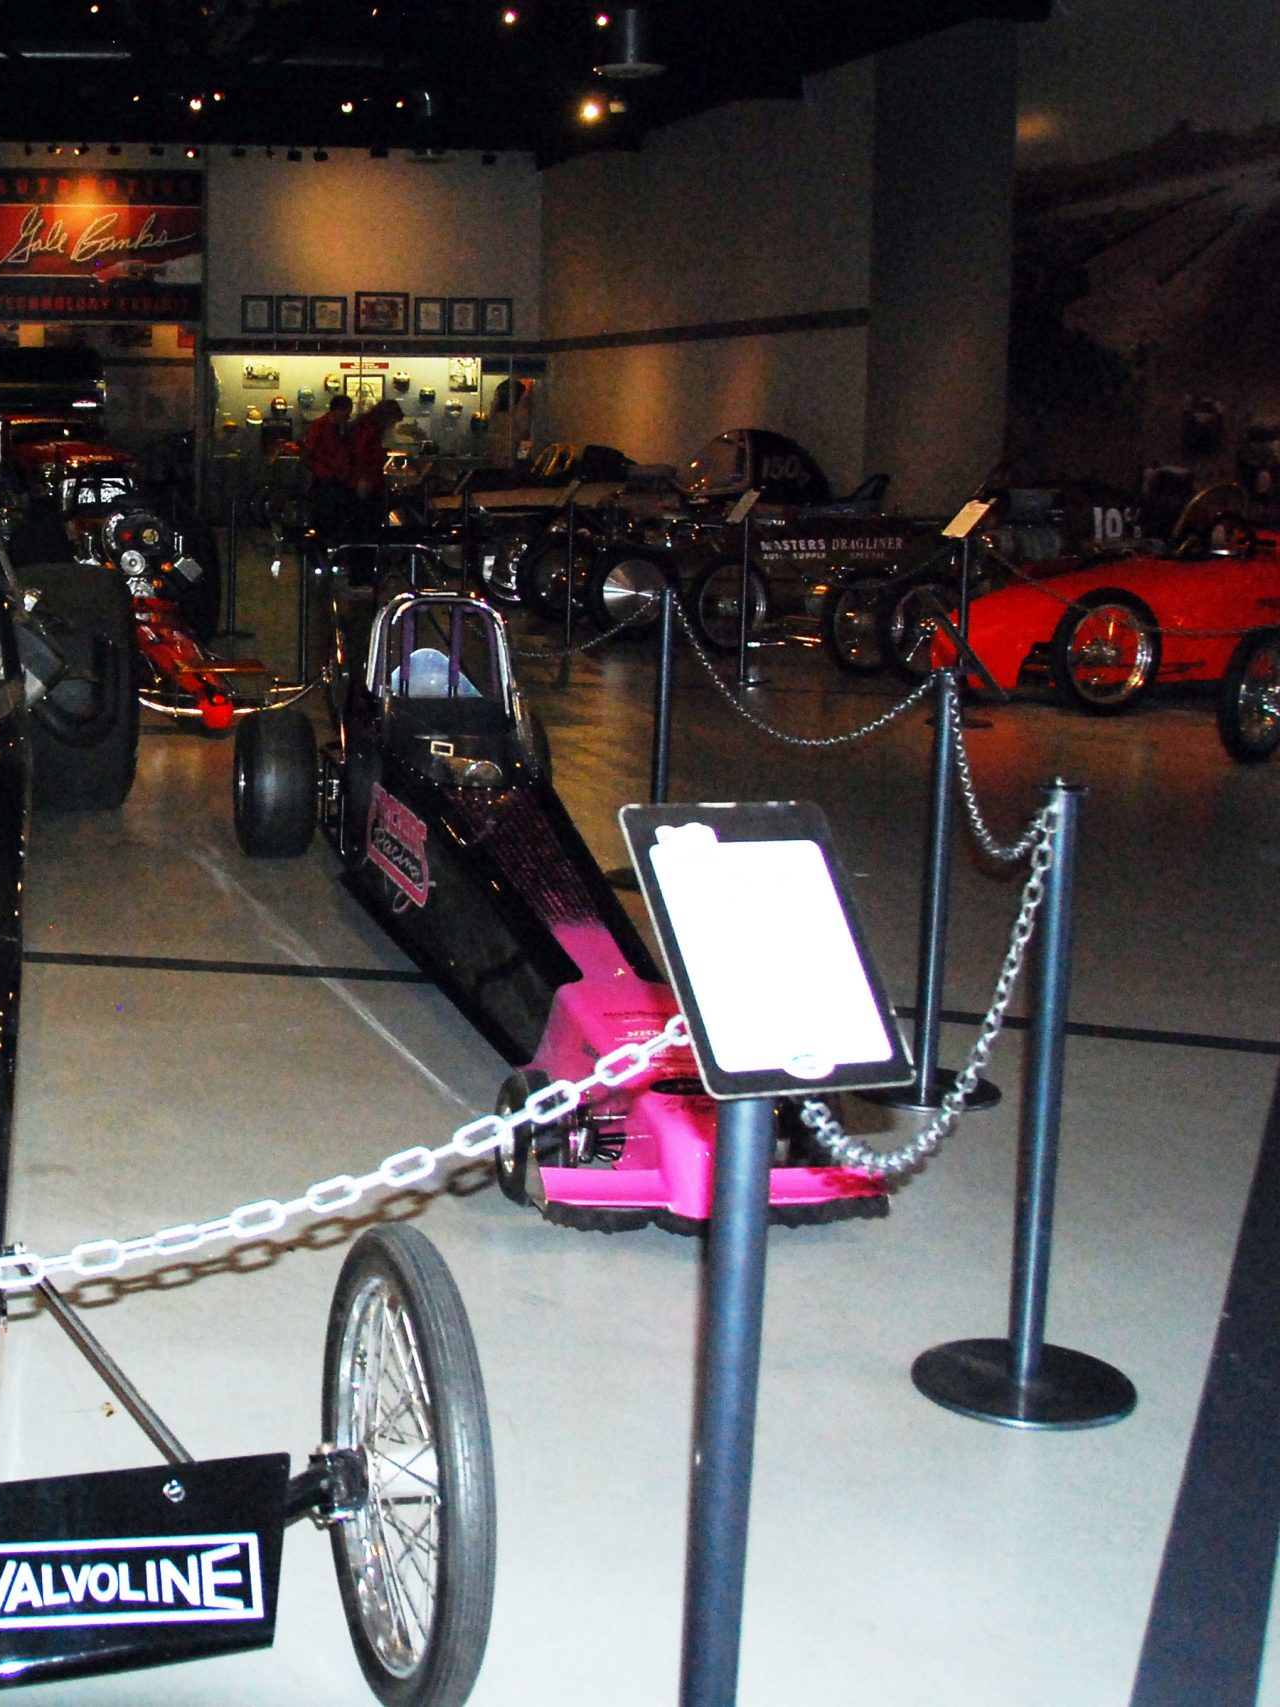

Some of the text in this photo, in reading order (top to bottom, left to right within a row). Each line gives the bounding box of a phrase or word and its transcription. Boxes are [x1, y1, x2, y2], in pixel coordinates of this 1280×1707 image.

[70, 212, 196, 262] Banks
[760, 537, 904, 551] MASTERS DRAGLINER
